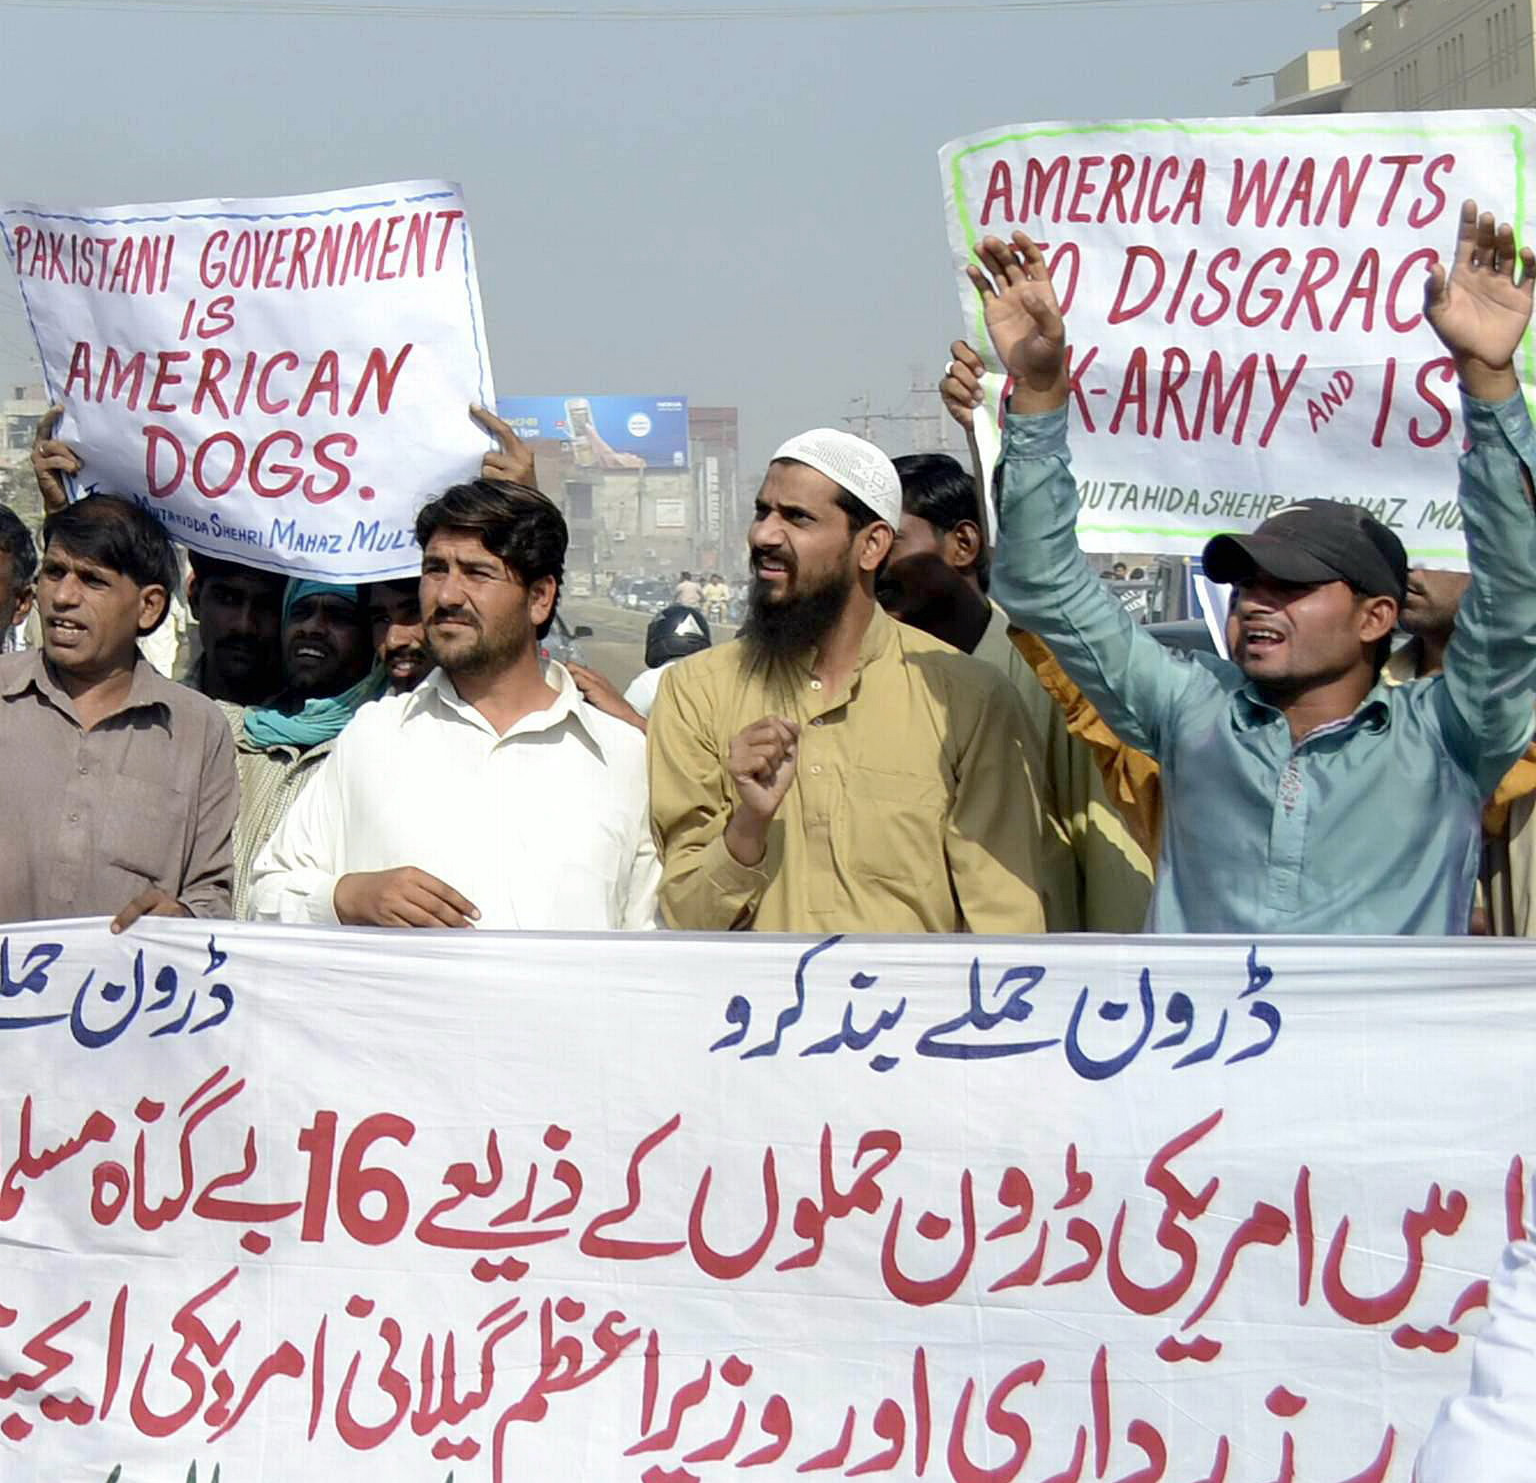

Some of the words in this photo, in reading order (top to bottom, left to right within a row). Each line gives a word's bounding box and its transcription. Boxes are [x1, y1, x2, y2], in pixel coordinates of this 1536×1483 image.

[980, 153, 1207, 226] AMERICA
[1228, 153, 1456, 229] WANTS
[14, 224, 175, 296] PAKISTANI
[199, 210, 465, 291] GOVERNMENT
[1107, 246, 1440, 333] DISGRAC
[179, 295, 236, 340] IS
[64, 341, 413, 420] AMERICAN
[1307, 370, 1355, 433] AND
[142, 424, 377, 504] DOGS.
[209, 513, 265, 547] SHEHRI
[268, 518, 343, 554] MAHAZ
[347, 519, 417, 553] MULT
[70, 933, 236, 1048] ڈرون
[710, 935, 846, 1060] کرو
[798, 973, 907, 1072] بند
[915, 957, 1061, 1060] حملے
[1064, 944, 1282, 1080] ڈرون
[298, 1110, 417, 1246] 16
[414, 1123, 584, 1283] ذریعے
[579, 1113, 687, 1261] کے
[688, 1121, 904, 1281] حملوں
[880, 1142, 1105, 1307] ڈرون
[1105, 1108, 1314, 1364] امریکی
[130, 1265, 327, 1444] امریکی
[335, 1296, 528, 1461] گیلانی
[797, 1345, 926, 1477] اور
